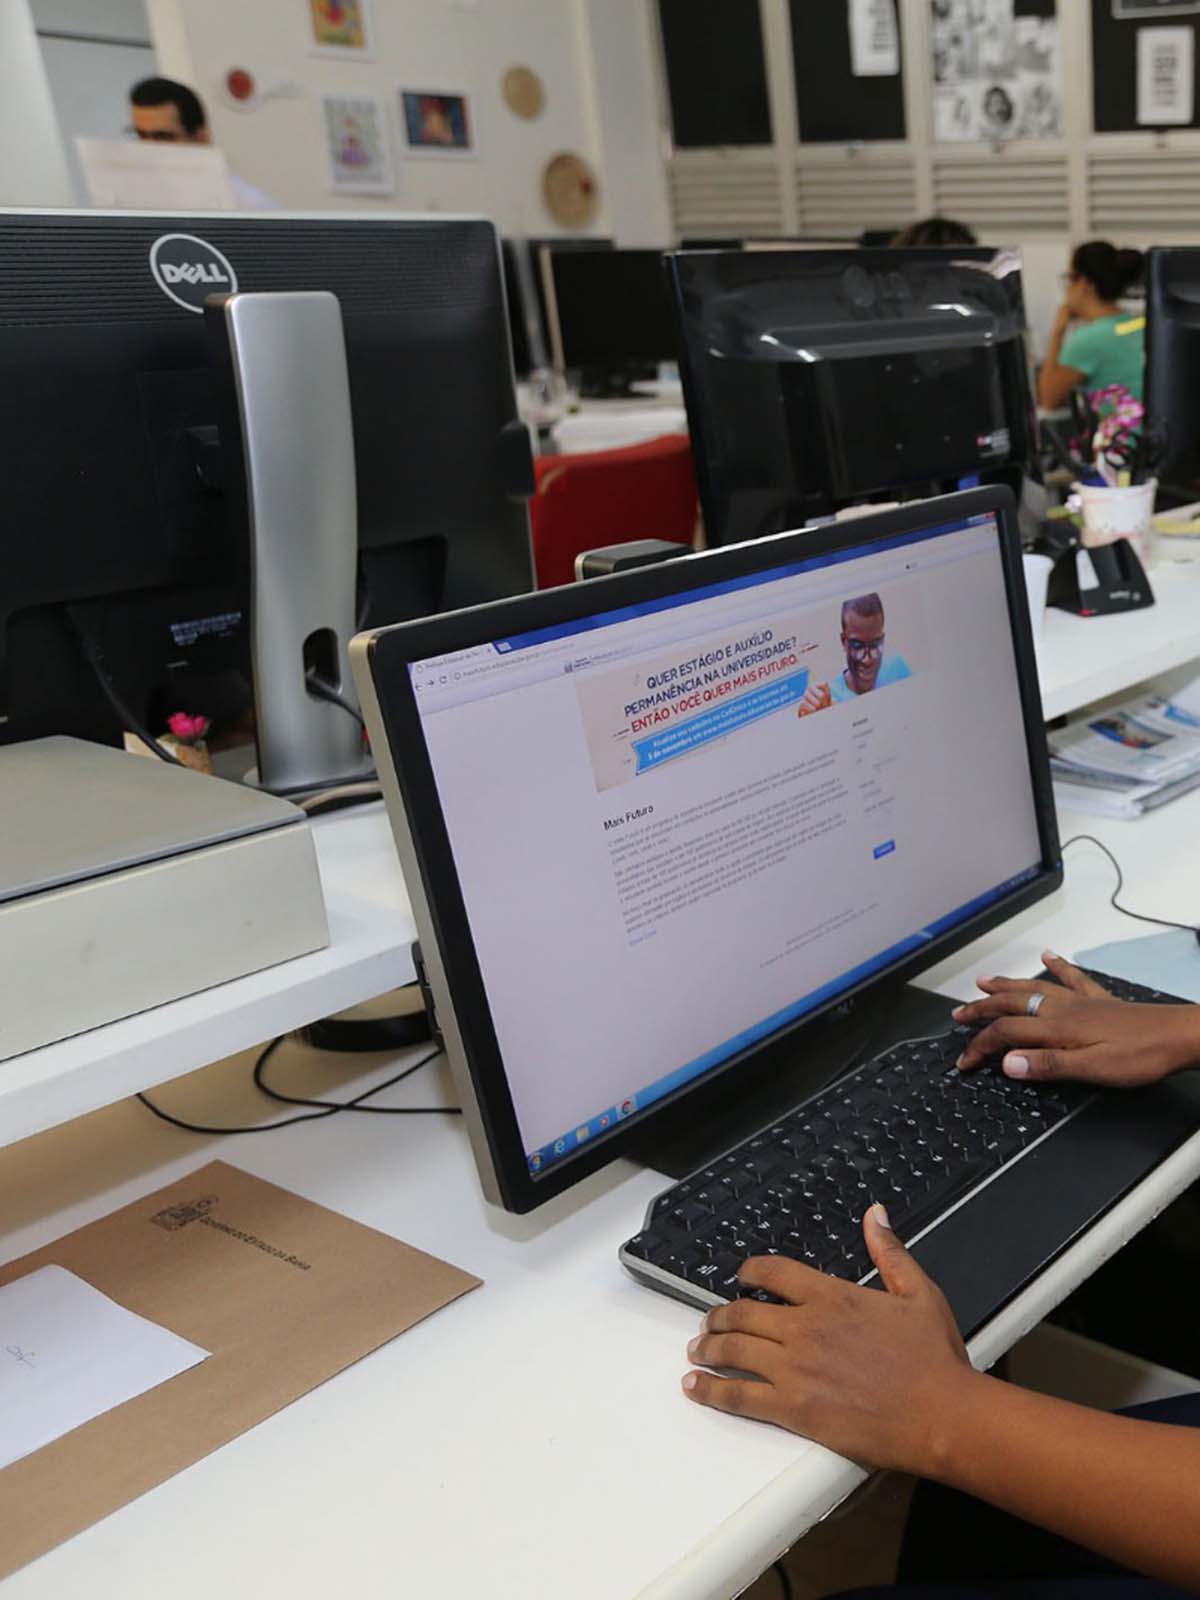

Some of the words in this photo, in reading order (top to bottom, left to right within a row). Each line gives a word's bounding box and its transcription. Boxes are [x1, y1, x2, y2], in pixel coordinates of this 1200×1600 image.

[160, 262, 229, 285] DELL
[623, 676, 704, 718] PERMANÊNCIA
[704, 668, 721, 685] NA
[722, 636, 797, 677] UNIVERSIDADE?
[647, 669, 679, 690] QUER
[679, 649, 726, 678] ESTÁGIO
[726, 645, 733, 657] E
[734, 629, 774, 654] AUXÍLIO
[631, 706, 671, 734] ENTÃO
[672, 692, 702, 716] VOCÊ
[703, 682, 732, 703] QUER
[733, 672, 758, 689] MAIS
[604, 818, 625, 831] Mais
[625, 805, 654, 822] Futuro
